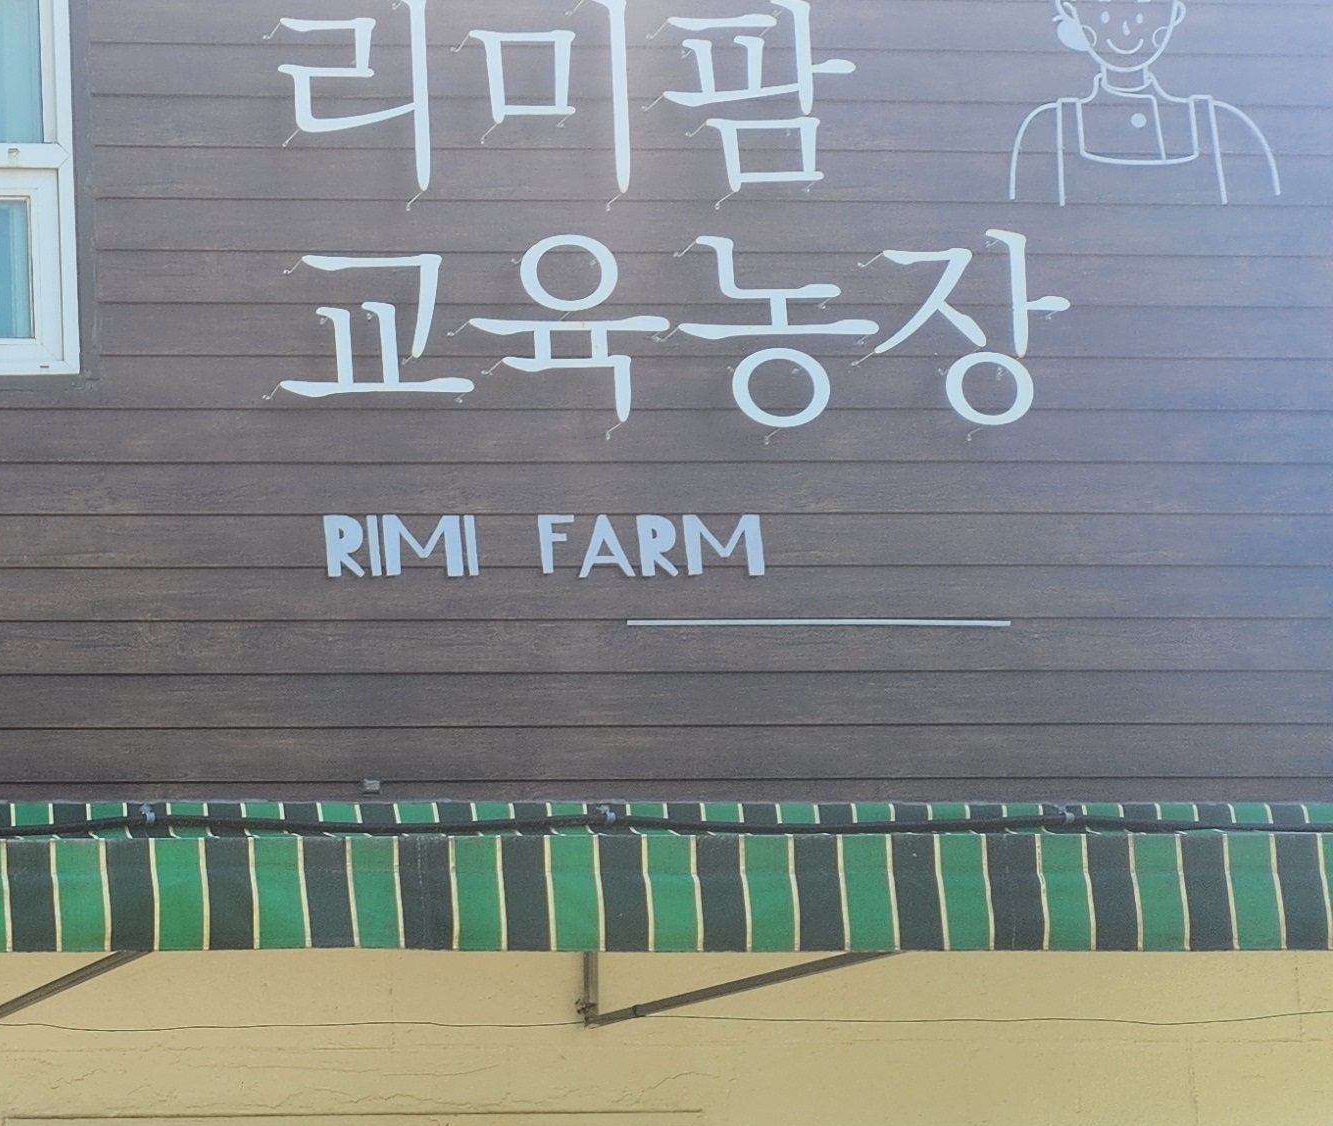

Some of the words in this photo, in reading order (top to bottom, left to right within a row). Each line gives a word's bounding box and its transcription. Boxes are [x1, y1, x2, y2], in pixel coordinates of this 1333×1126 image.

[277, 0, 857, 192] 리미팜
[280, 229, 1071, 428] 교육농장
[323, 514, 480, 578] RIMI
[537, 514, 766, 578] FARM
